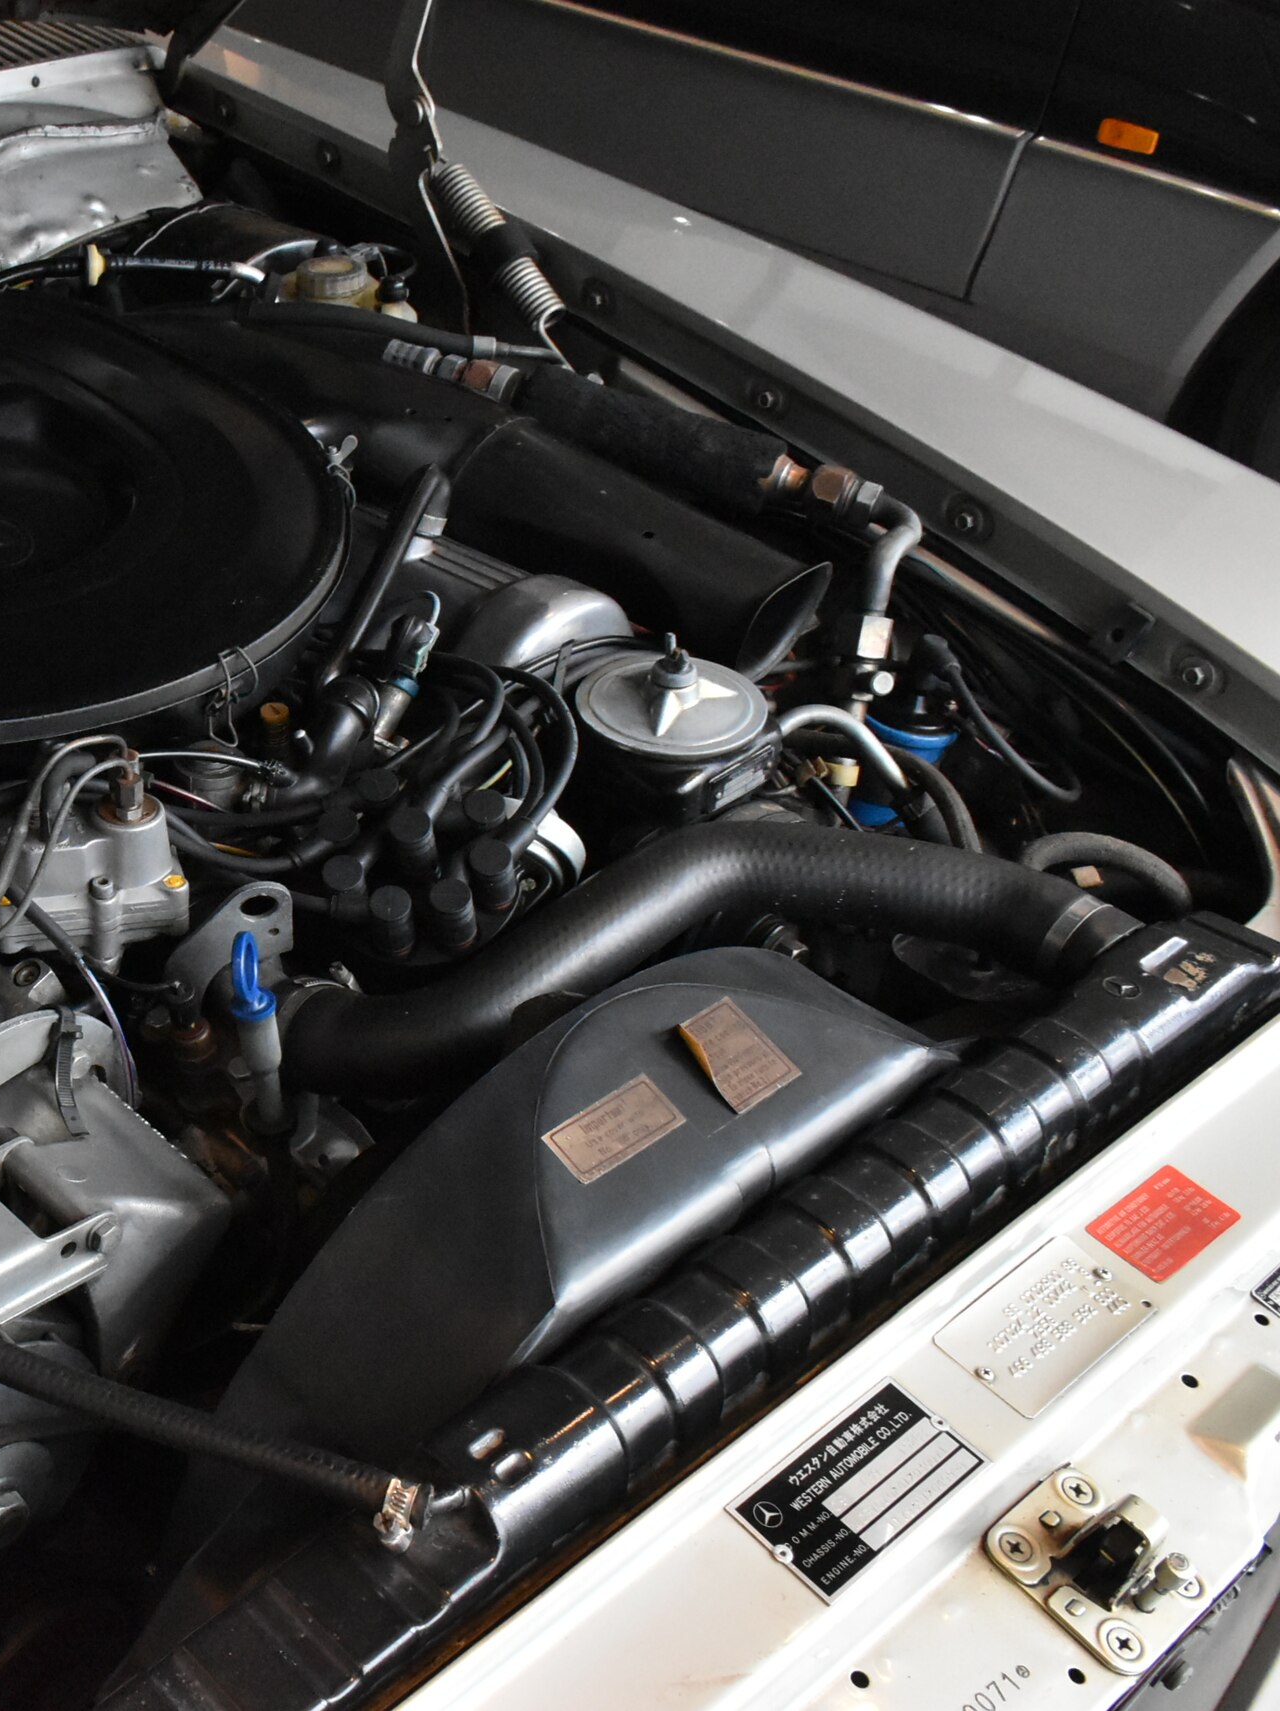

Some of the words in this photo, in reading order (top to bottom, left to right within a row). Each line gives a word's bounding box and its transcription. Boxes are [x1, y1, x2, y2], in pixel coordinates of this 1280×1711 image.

[788, 1403, 890, 1487] ウエスタン自動車株式会社
[789, 1477, 833, 1513] WESTERN
[831, 1434, 881, 1479] AUTOMOBILE
